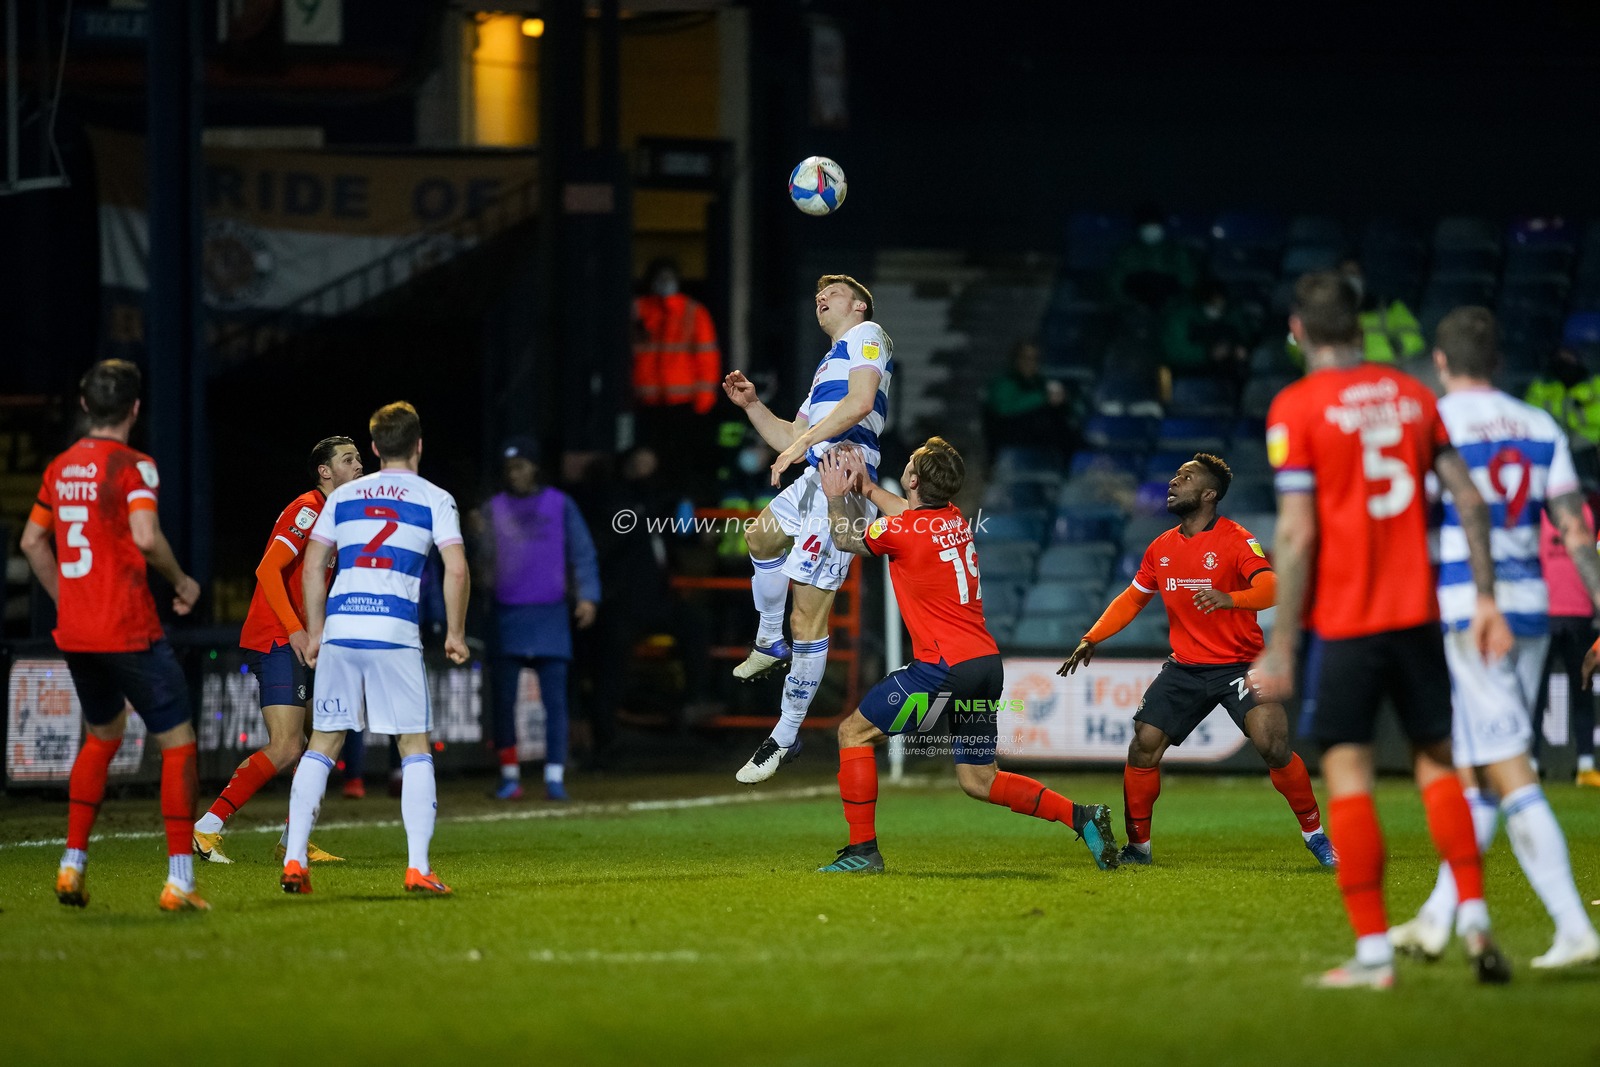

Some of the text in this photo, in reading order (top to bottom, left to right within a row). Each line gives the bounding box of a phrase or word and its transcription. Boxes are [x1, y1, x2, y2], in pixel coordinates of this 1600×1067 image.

[204, 166, 369, 220] RIDE
[1359, 424, 1415, 520] 5
[1489, 447, 1532, 529] 9
[58, 481, 98, 501] POTTS
[363, 485, 409, 501] KANE
[58, 505, 93, 579] 3
[355, 506, 400, 568] 2
[802, 534, 821, 554] 4
[938, 541, 982, 605] 19
[1165, 577, 1177, 591] JB
[338, 603, 390, 613] AGGREGATES
[345, 596, 384, 605] ASHVILLE
